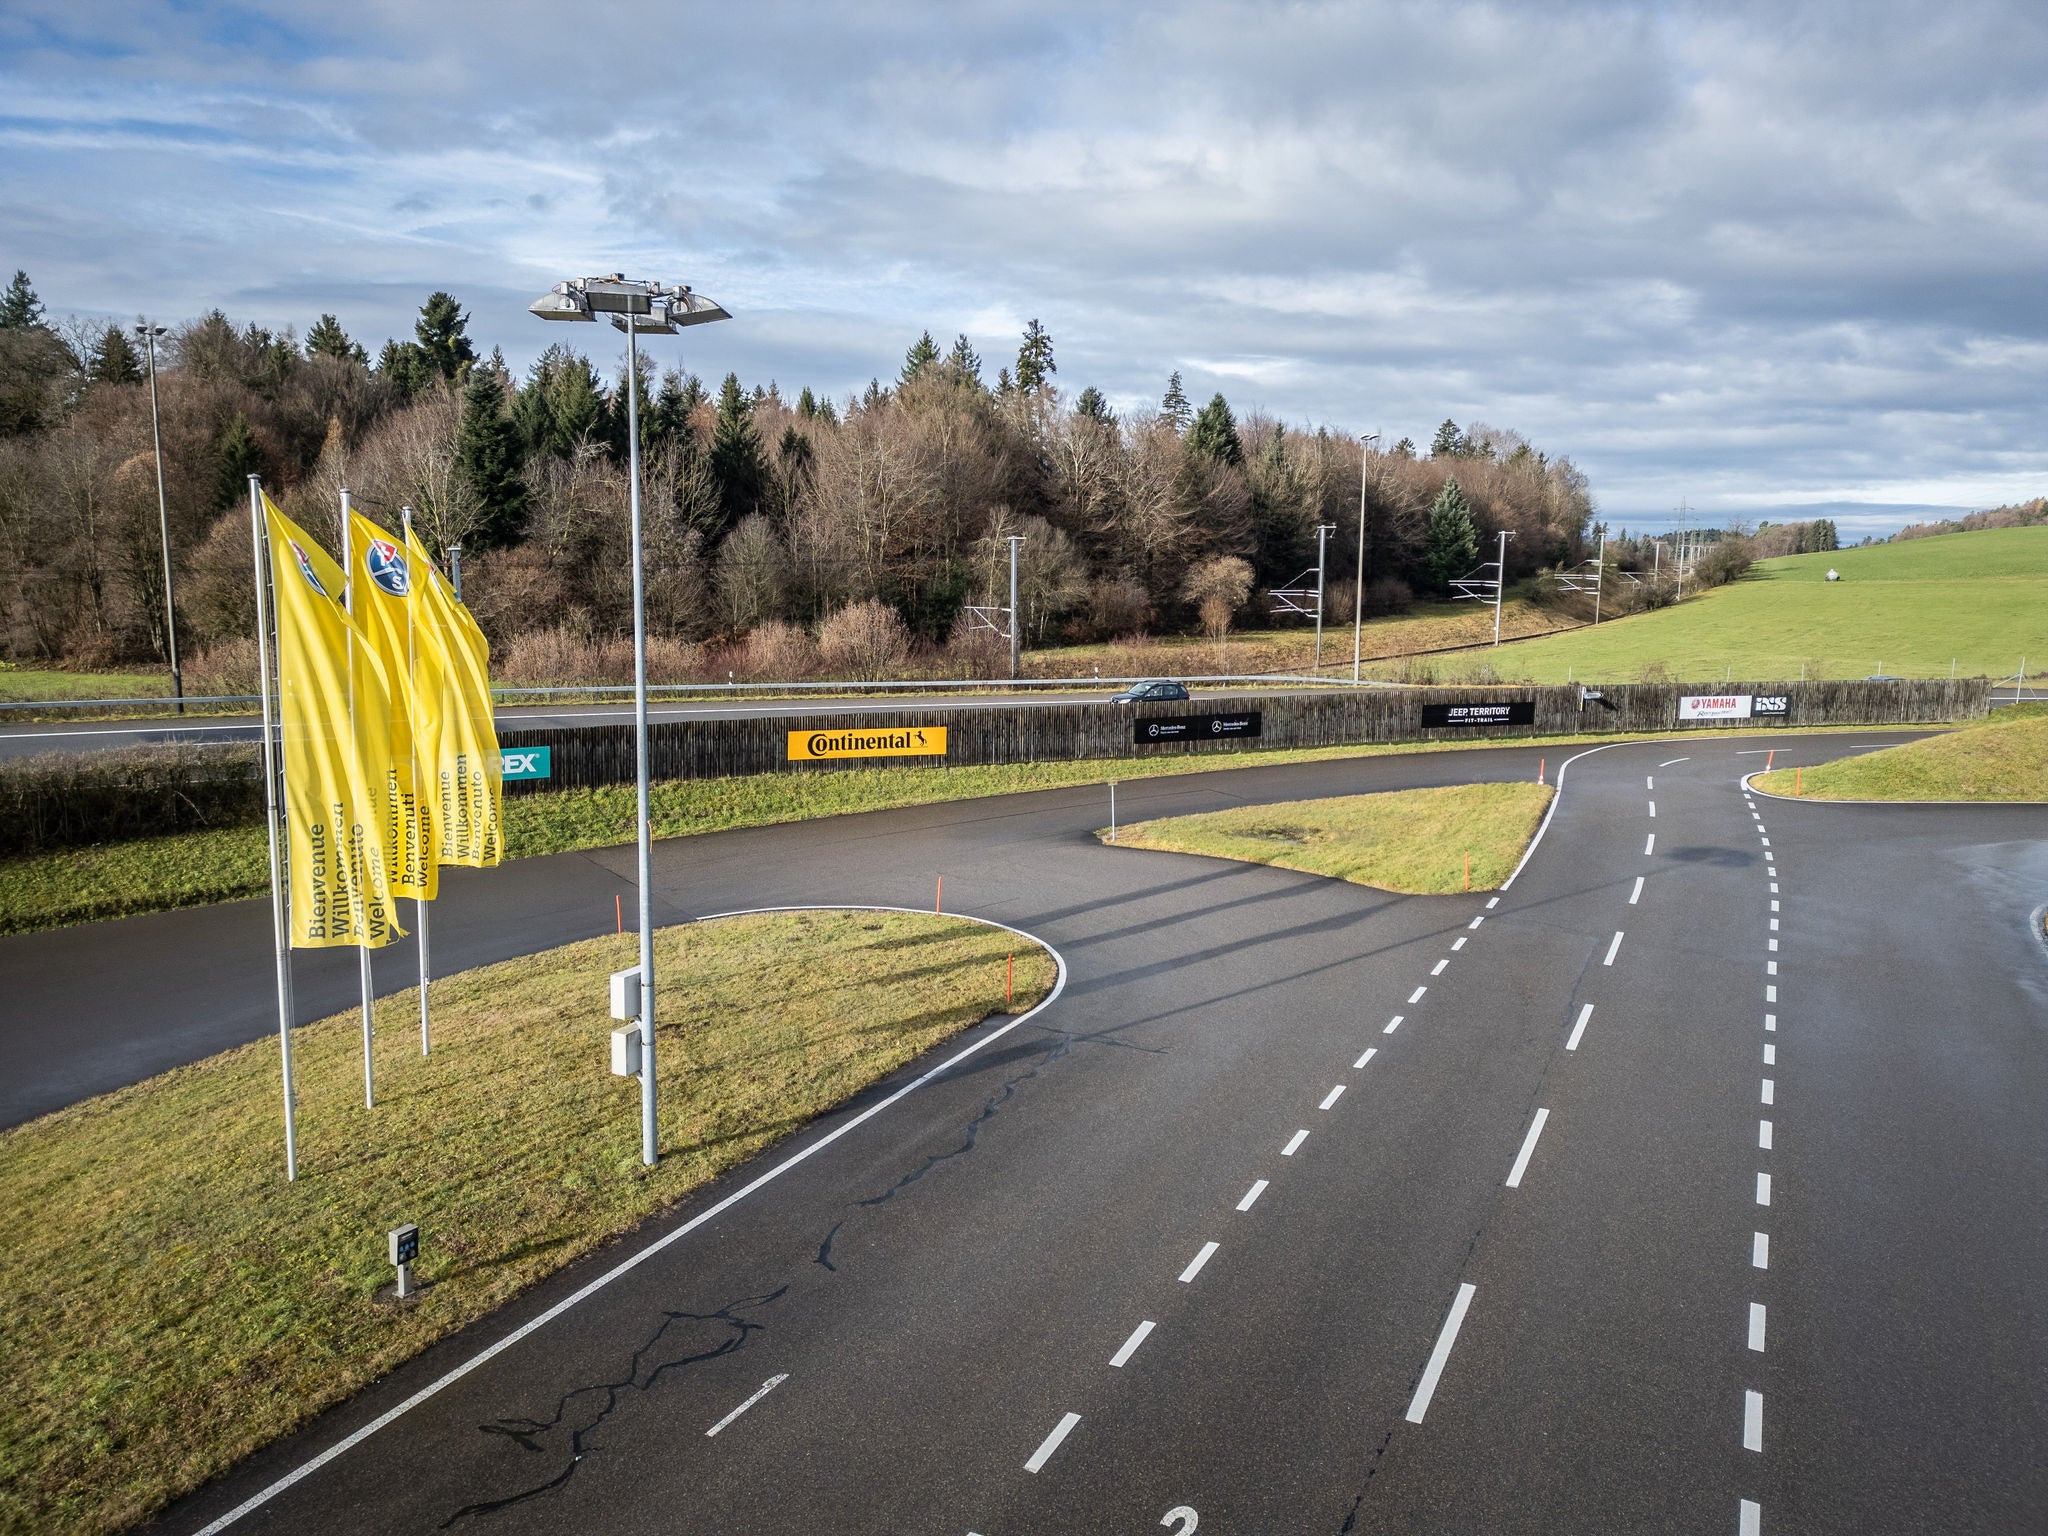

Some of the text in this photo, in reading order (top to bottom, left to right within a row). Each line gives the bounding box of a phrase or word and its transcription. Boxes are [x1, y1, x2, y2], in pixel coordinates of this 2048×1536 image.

[807, 731, 911, 757] Continental
[1470, 707, 1510, 716] TERRITORY
[1701, 698, 1737, 709] YAMAHA
[417, 806, 430, 887] Welcome
[441, 771, 453, 858] Bienvenue
[456, 754, 469, 859] Willkommen
[471, 771, 482, 860] Benvenuto
[308, 823, 326, 939] Bienvenue
[332, 802, 350, 938] Willkommen
[368, 846, 385, 940] Welcome
